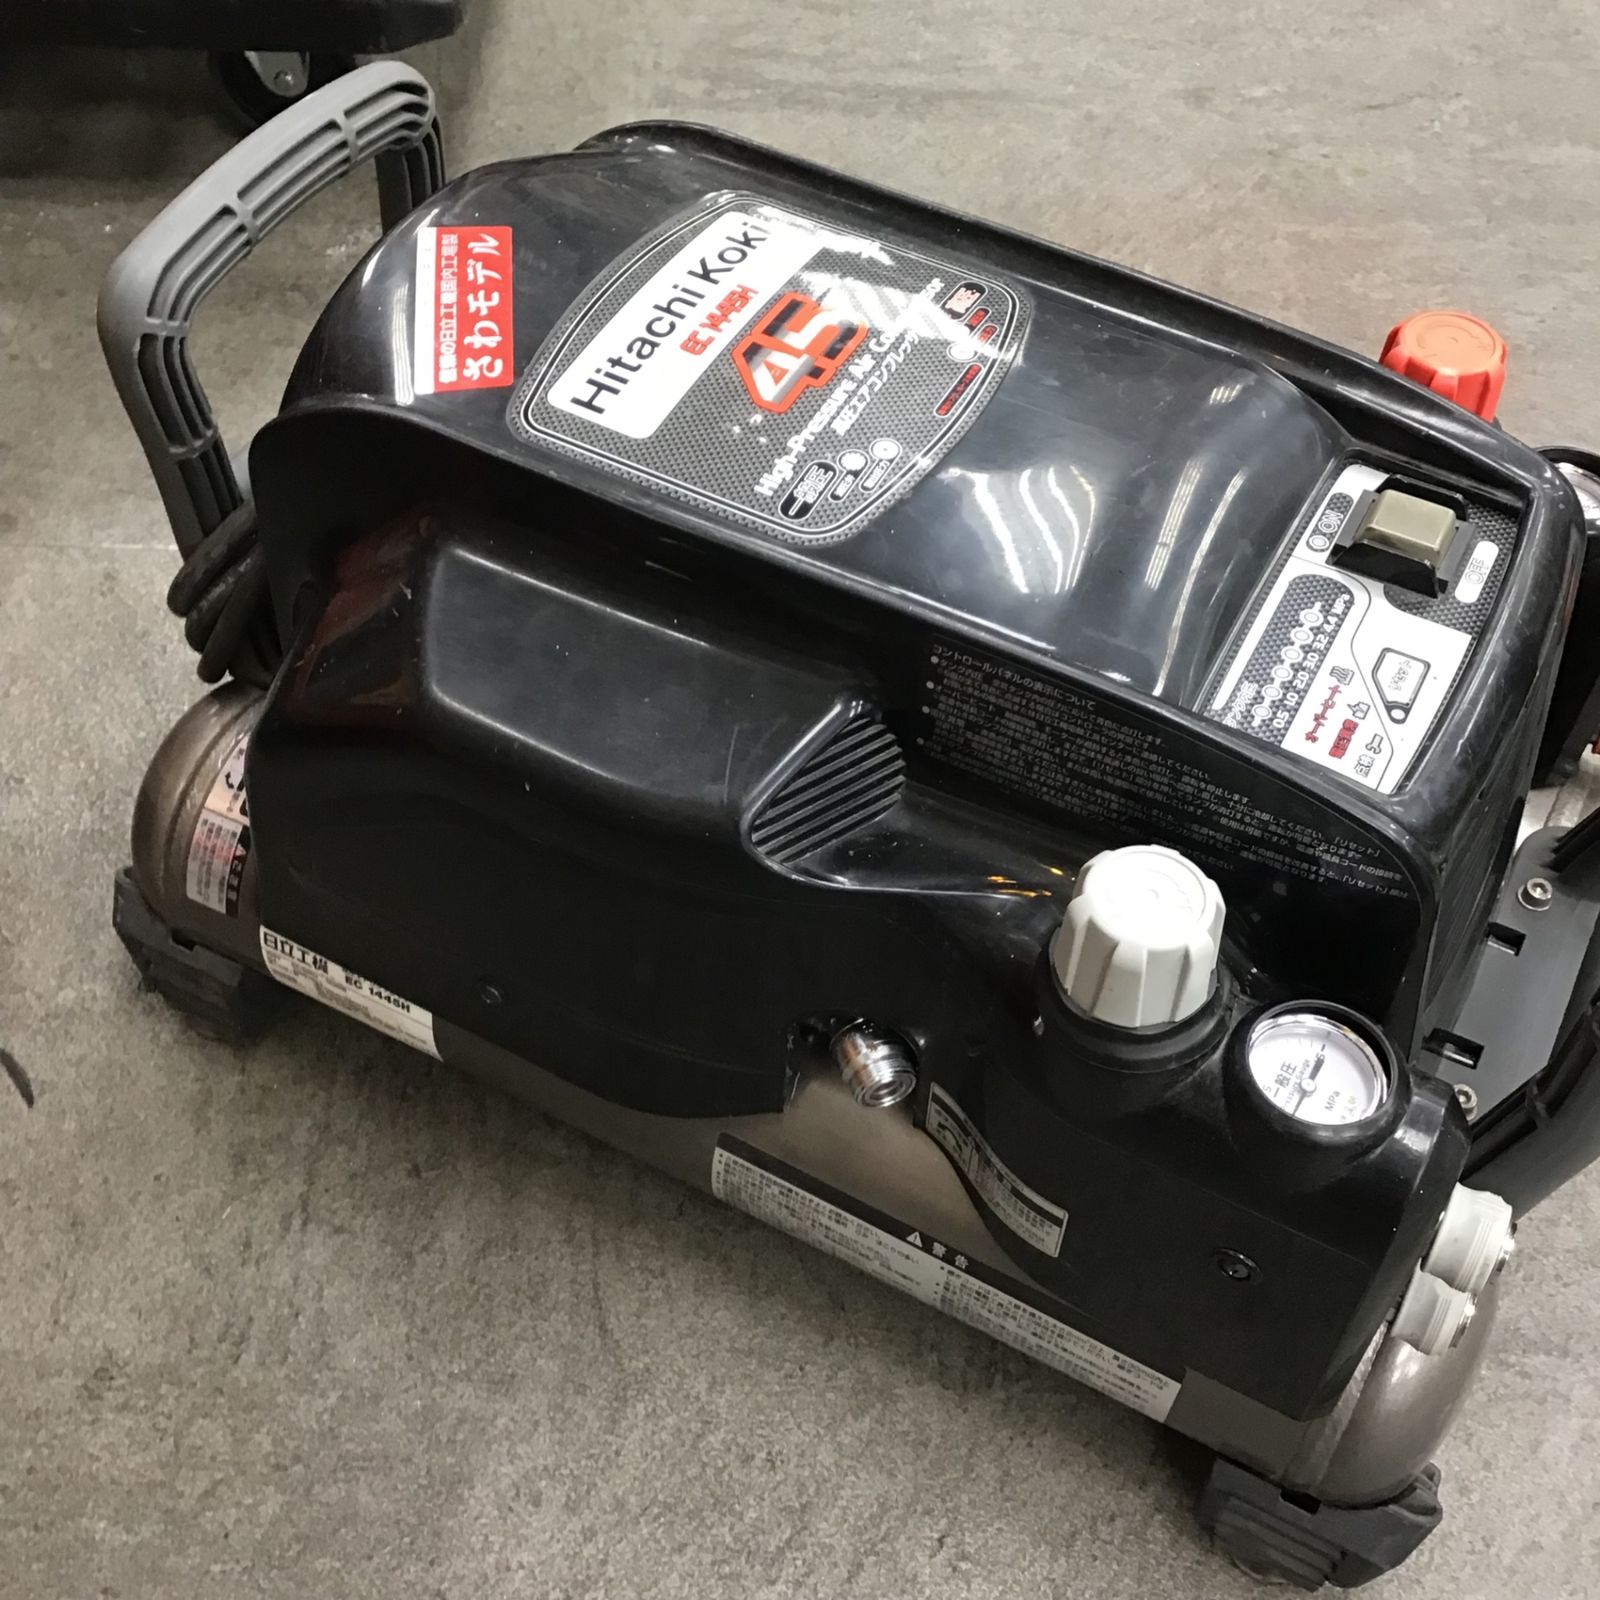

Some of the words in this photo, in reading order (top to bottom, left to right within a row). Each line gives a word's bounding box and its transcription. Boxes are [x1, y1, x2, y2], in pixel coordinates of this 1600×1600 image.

[462, 233, 502, 380] さわモデル
[570, 285, 699, 414] Hitachi
[687, 221, 768, 285] Koki
[680, 327, 713, 355] EC
[700, 284, 759, 333] 1445H
[732, 290, 869, 413] 45
[755, 374, 859, 496] High-Pressure
[850, 355, 876, 389] Air
[1318, 509, 1344, 533] ON
[1331, 593, 1350, 616] MPa
[1464, 557, 1490, 584] OFF
[1325, 1090, 1341, 1111] MPa
